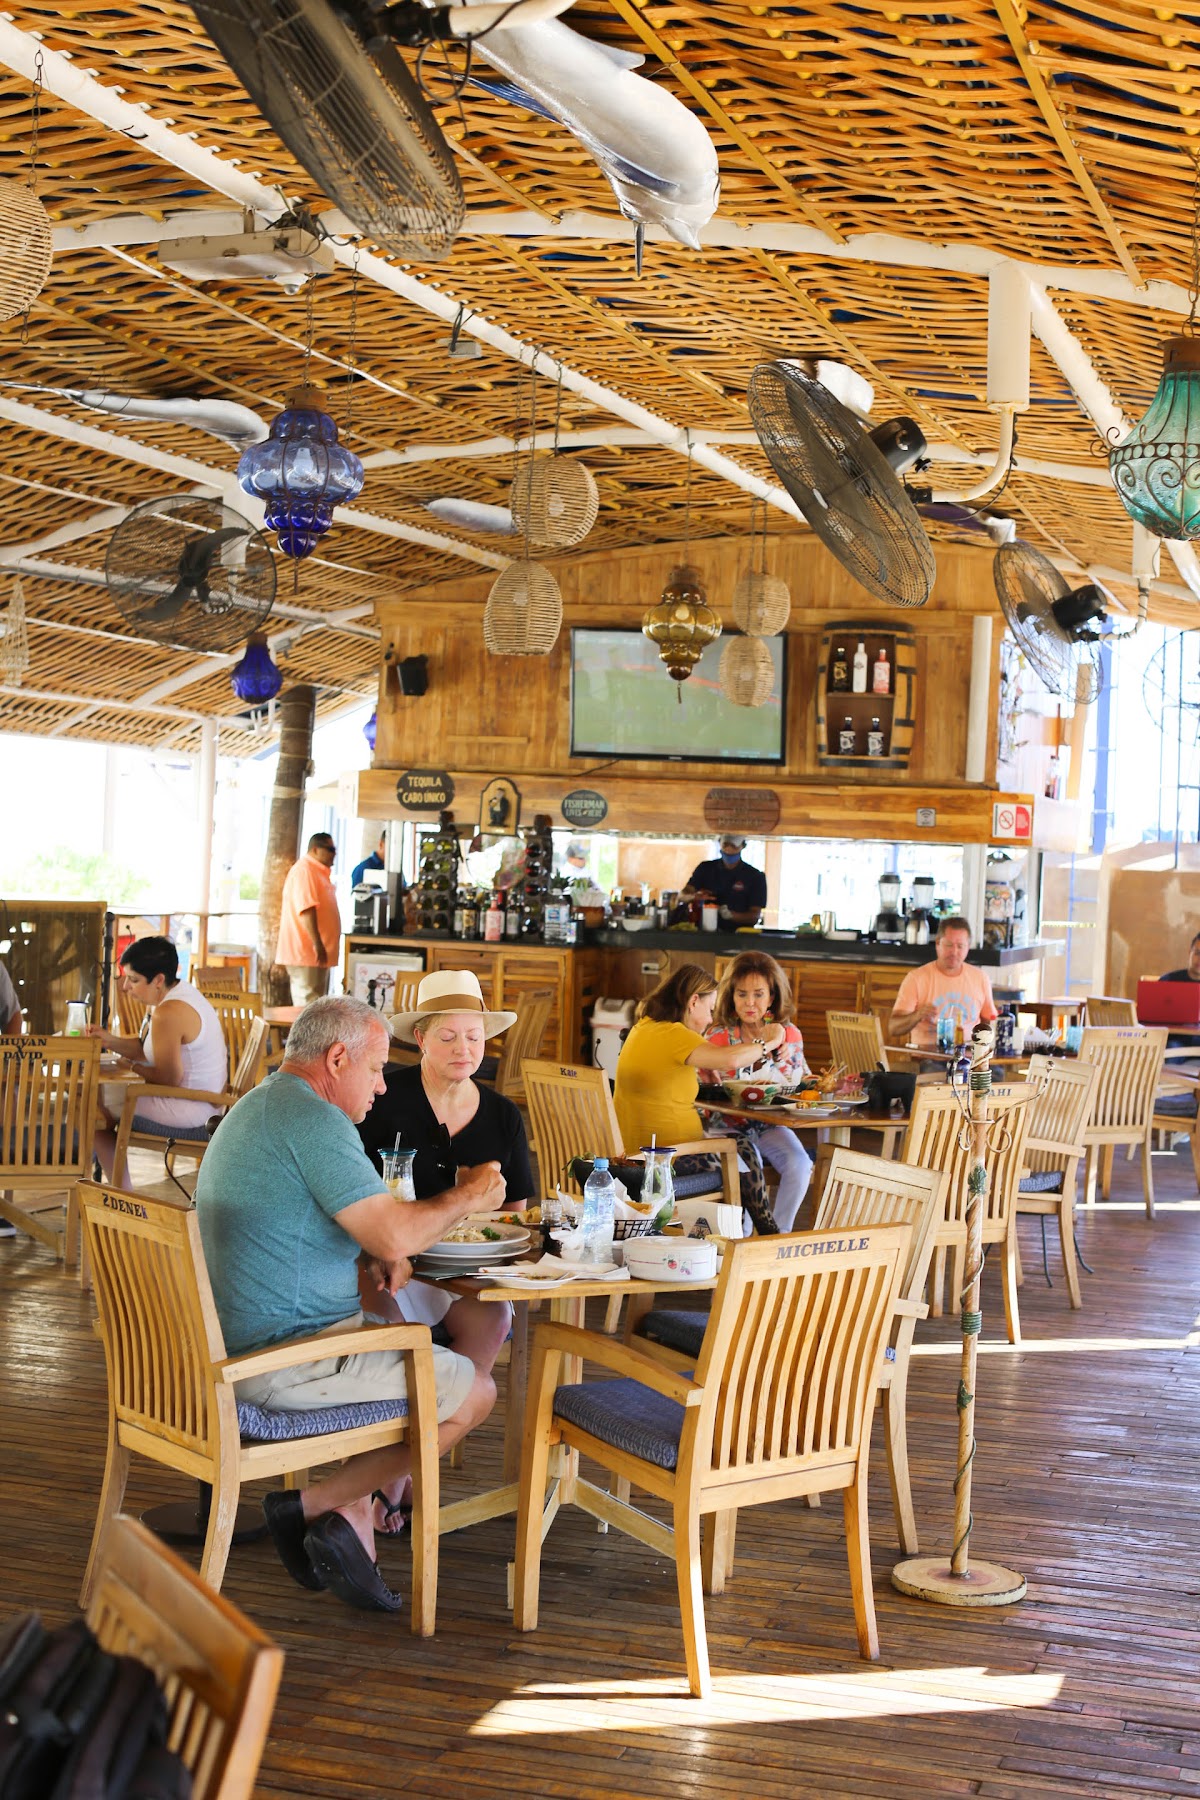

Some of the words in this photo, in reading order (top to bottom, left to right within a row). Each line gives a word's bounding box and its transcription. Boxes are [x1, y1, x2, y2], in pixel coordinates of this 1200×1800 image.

[408, 776, 442, 788] TEQUILA
[402, 791, 422, 804] CABO
[564, 799, 605, 809] FISHERMAN
[203, 992, 240, 1001] CARSON
[4, 1051, 43, 1059] DAVID
[776, 1237, 870, 1260] MICHELLE
